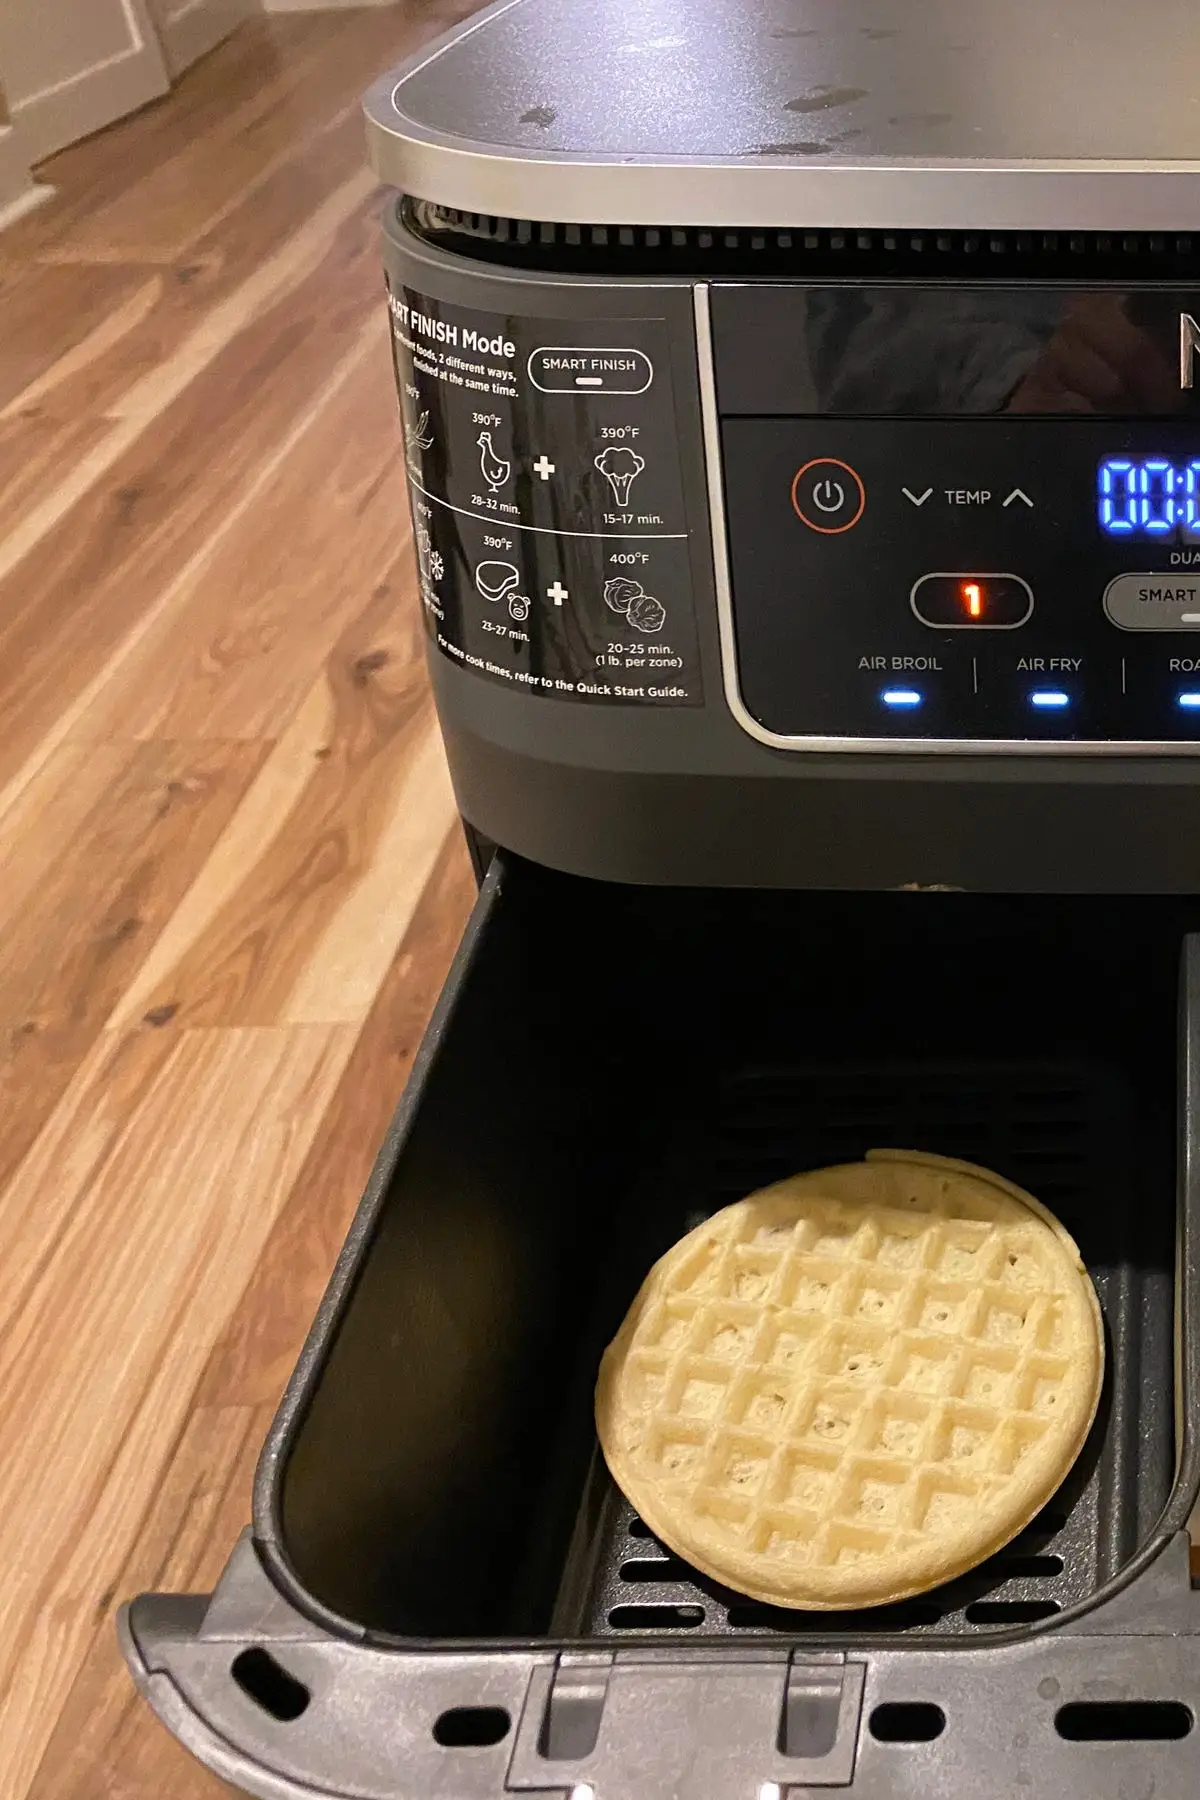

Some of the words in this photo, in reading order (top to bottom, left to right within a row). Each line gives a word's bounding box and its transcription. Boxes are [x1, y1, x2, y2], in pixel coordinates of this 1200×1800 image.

[411, 310, 457, 346] FINISH
[462, 328, 516, 358] Mode
[439, 353, 445, 364] 2
[445, 355, 485, 375] different
[487, 367, 517, 382] ways,
[542, 358, 586, 370] SMART
[591, 359, 636, 371] FINISH
[439, 370, 448, 381] at
[449, 373, 464, 386] the
[465, 378, 490, 392] same
[492, 383, 519, 397] time.
[472, 412, 502, 428] 390°F
[601, 425, 640, 439] 390°F
[944, 490, 992, 506] TEMP
[500, 502, 521, 515] min.
[637, 513, 664, 525] min.
[483, 535, 513, 551] 390°F
[609, 551, 650, 565] 400°F
[963, 583, 982, 617] 1
[1138, 588, 1197, 602] SMART
[508, 629, 531, 643] min.
[648, 644, 674, 655] min.
[437, 634, 449, 648] For
[447, 642, 465, 659] more
[465, 653, 485, 668] cook
[485, 660, 513, 680] times,
[514, 671, 540, 686] refer
[541, 677, 553, 688] to
[555, 679, 574, 692] the
[576, 681, 612, 697] Quick
[614, 684, 645, 697] Start
[647, 685, 689, 699] Guide.
[595, 655, 606, 668] (1
[608, 656, 623, 668] lb.
[625, 658, 646, 669] per
[649, 656, 683, 669] zone)
[858, 657, 891, 671] AIR
[894, 657, 943, 671] BROIL
[1016, 658, 1043, 672] AIR
[1046, 658, 1083, 672] FRY
